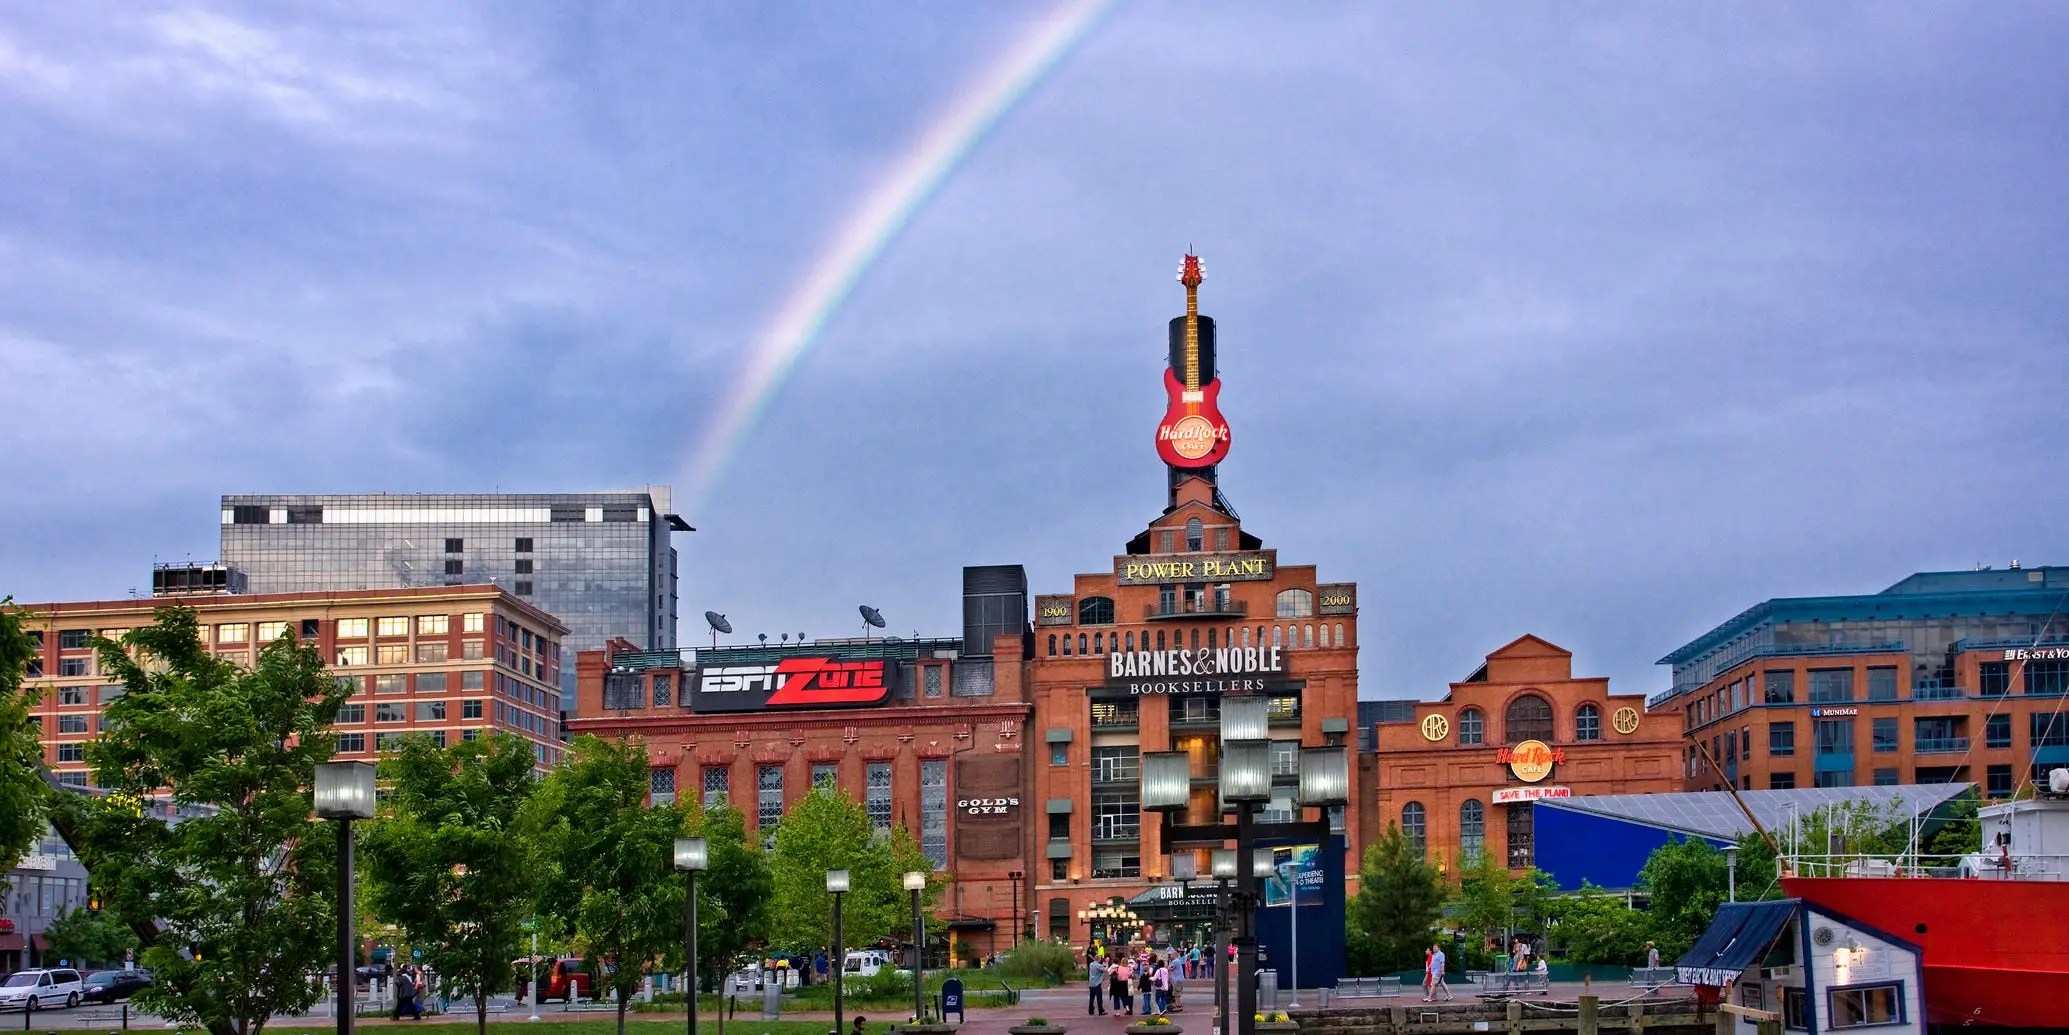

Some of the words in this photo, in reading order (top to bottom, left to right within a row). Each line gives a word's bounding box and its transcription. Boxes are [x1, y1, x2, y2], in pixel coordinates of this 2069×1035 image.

[1160, 426, 1195, 440] Hard
[1195, 424, 1228, 441] Rock
[1126, 563, 1194, 580] POWER
[1203, 559, 1266, 577] PLANT
[1323, 595, 1350, 606] 2000
[1044, 606, 1067, 617] 1900
[1130, 679, 1265, 695] BOOKSELLERS
[1496, 748, 1531, 764] Hard
[1532, 747, 1565, 766] Rock
[1521, 765, 1542, 773] CAFE
[1500, 790, 1520, 800] SAVE
[1524, 789, 1541, 798] THE
[958, 797, 1019, 807] GOLD'S
[968, 806, 1007, 814] GYM
[1973, 1007, 1982, 1015] 6
